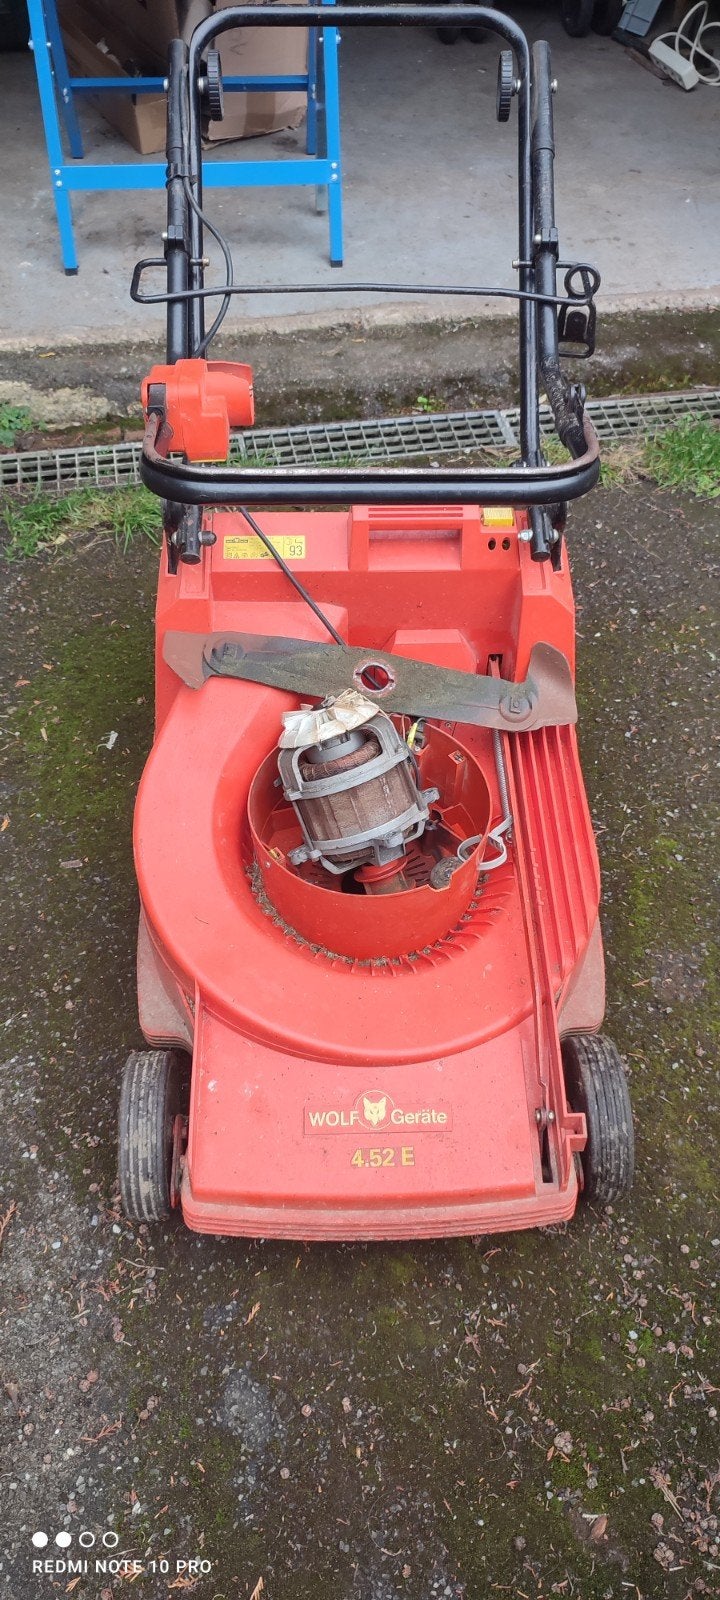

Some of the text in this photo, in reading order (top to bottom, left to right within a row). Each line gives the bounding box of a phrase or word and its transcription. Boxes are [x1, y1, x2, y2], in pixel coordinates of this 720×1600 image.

[289, 545, 303, 557] 93
[308, 1108, 448, 1127] WOLF Geräte
[351, 1146, 416, 1168] 4.52 E
